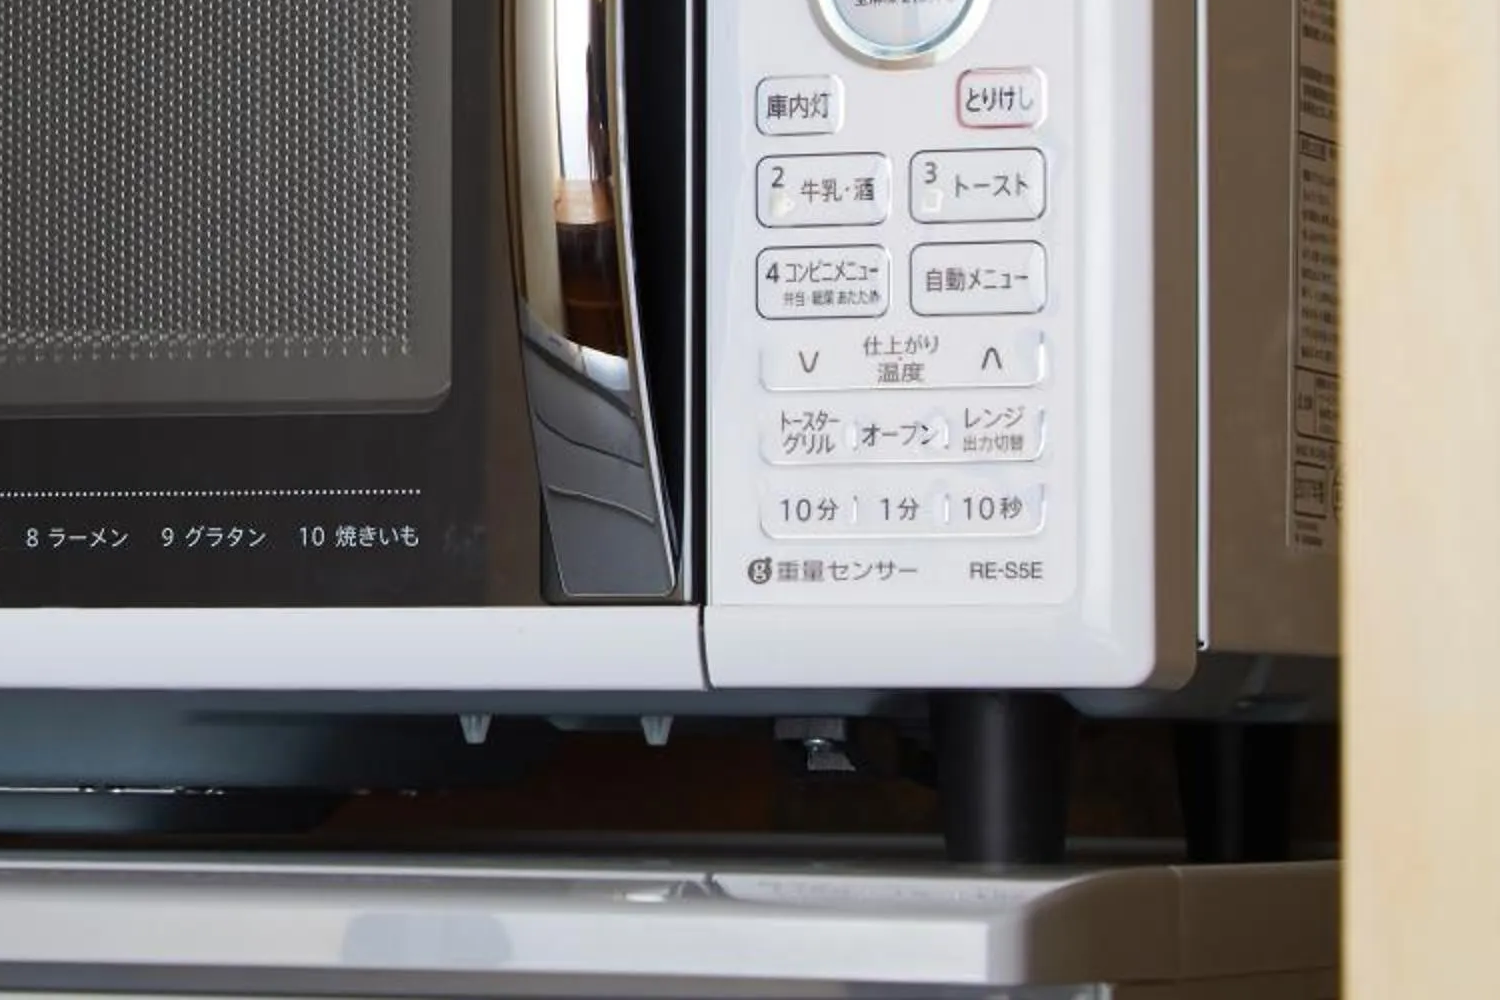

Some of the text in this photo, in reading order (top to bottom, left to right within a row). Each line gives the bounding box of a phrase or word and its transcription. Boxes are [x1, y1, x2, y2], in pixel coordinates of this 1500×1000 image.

[766, 92, 832, 120] 庫内灯
[965, 86, 1034, 113] とりけし
[770, 166, 785, 189] 2
[924, 161, 1030, 198] 3 トースト
[765, 262, 780, 283] 4
[926, 267, 1029, 292] 自動メニュー
[863, 335, 940, 356] 仕上がり
[877, 363, 925, 383] 温度
[781, 409, 841, 431] トースター
[965, 406, 1025, 429] レンジ
[784, 433, 836, 455] グリル
[963, 435, 1025, 452] 出力切替
[26, 528, 39, 548] 8
[48, 527, 130, 548] ラーメン
[161, 527, 174, 548] 9
[185, 526, 267, 548] グラタン
[299, 526, 326, 547] 10
[334, 526, 420, 548] 焼きいも
[970, 561, 1043, 580] RE-S5E
